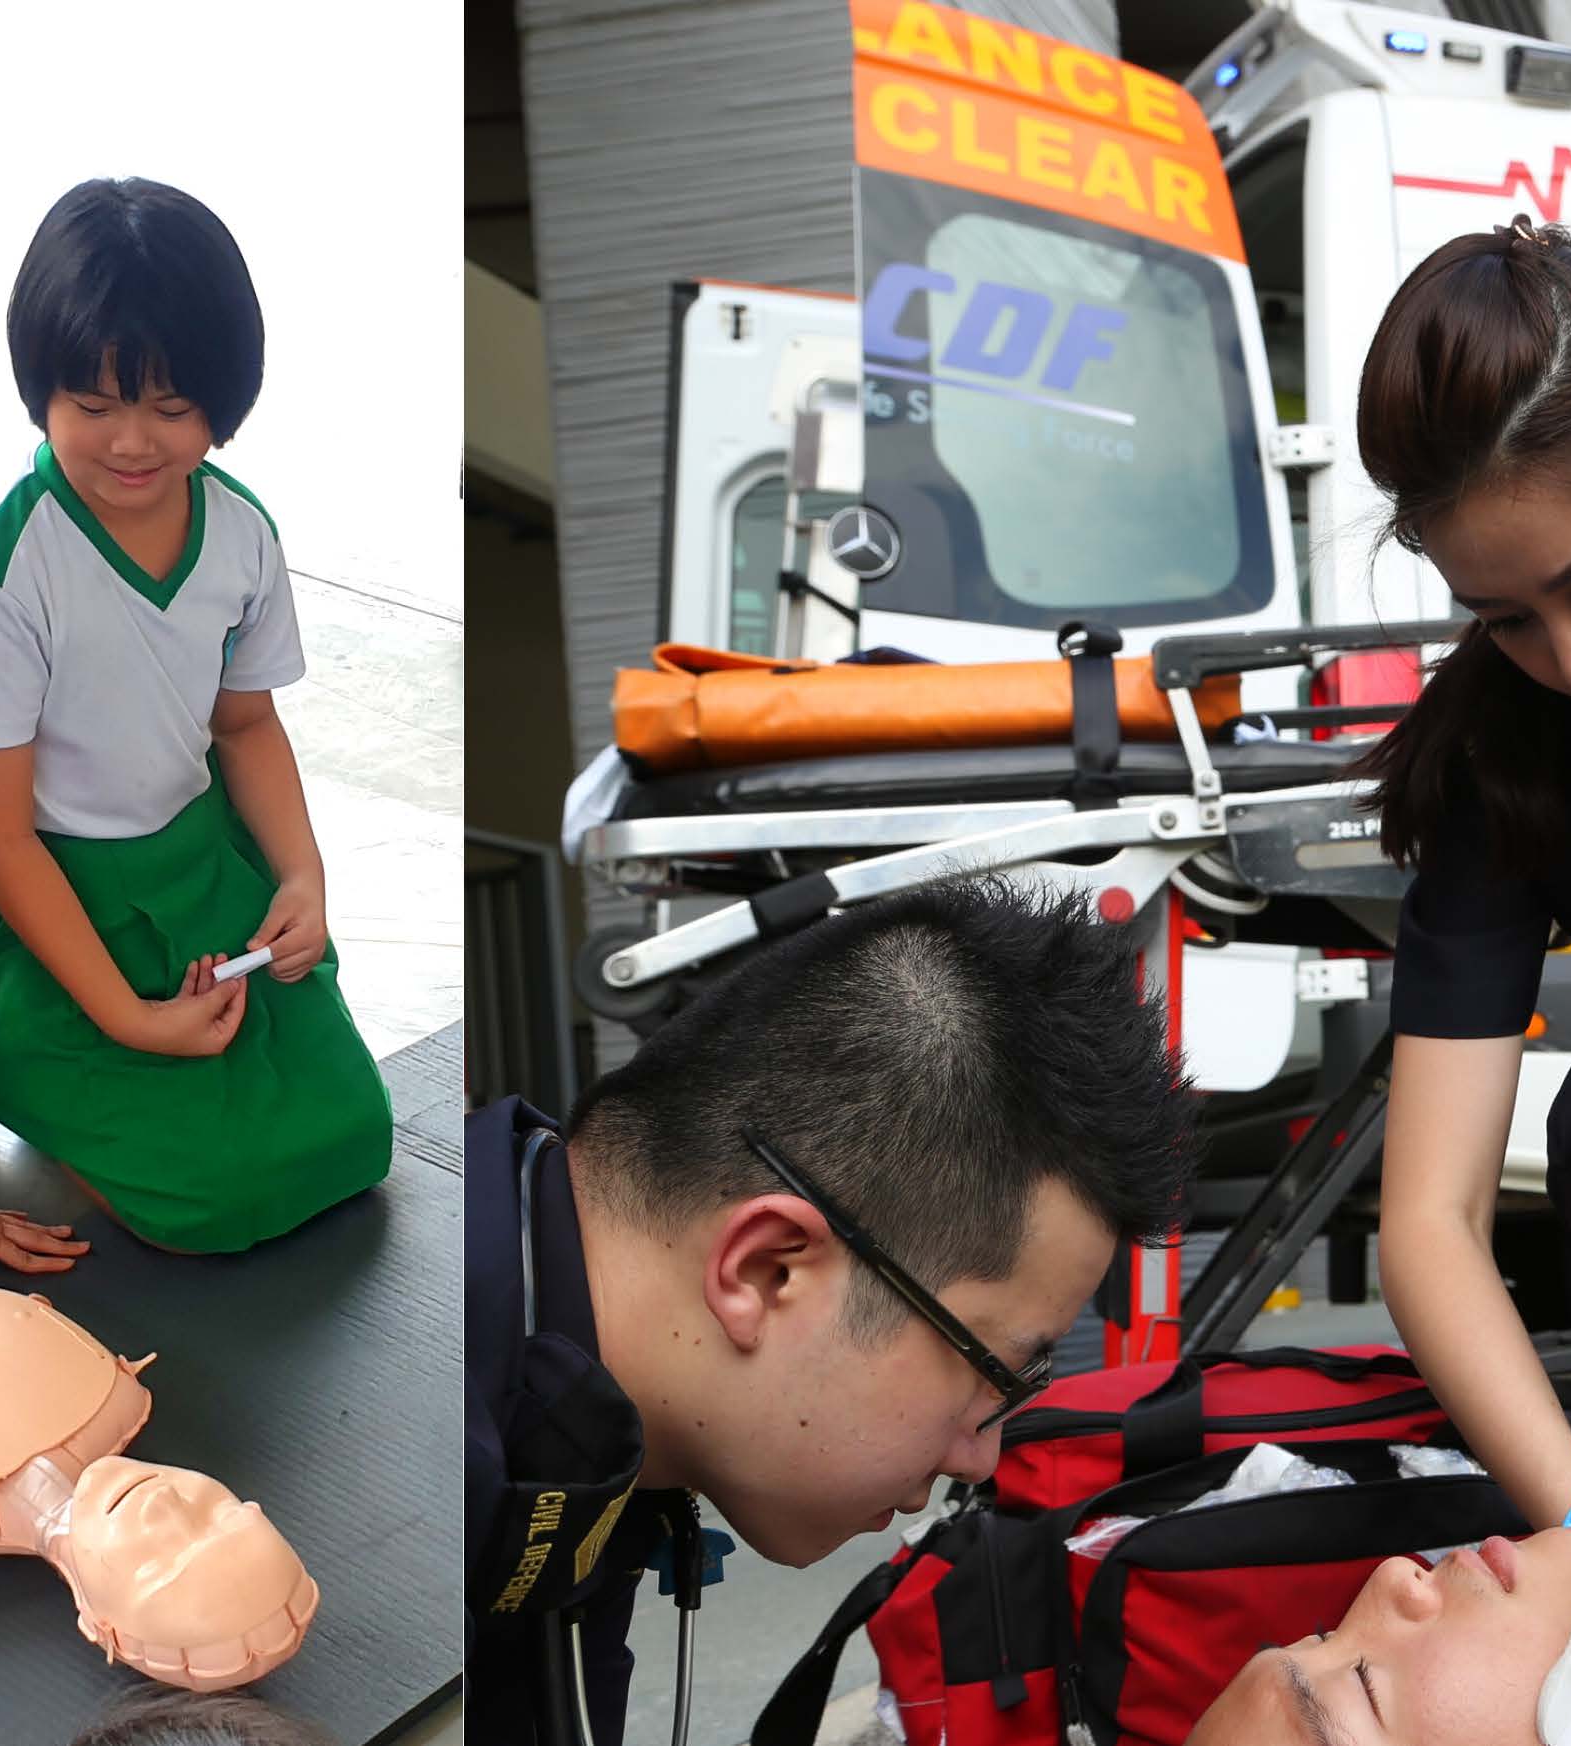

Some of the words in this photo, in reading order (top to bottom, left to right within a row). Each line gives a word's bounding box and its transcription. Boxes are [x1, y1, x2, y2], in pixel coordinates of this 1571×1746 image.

[855, 0, 1185, 145] ANCE
[870, 82, 1213, 234] CLEAR
[863, 262, 1130, 393] CDF
[491, 1542, 553, 1613] DEFENCE
[528, 1490, 567, 1542] CIVIL
